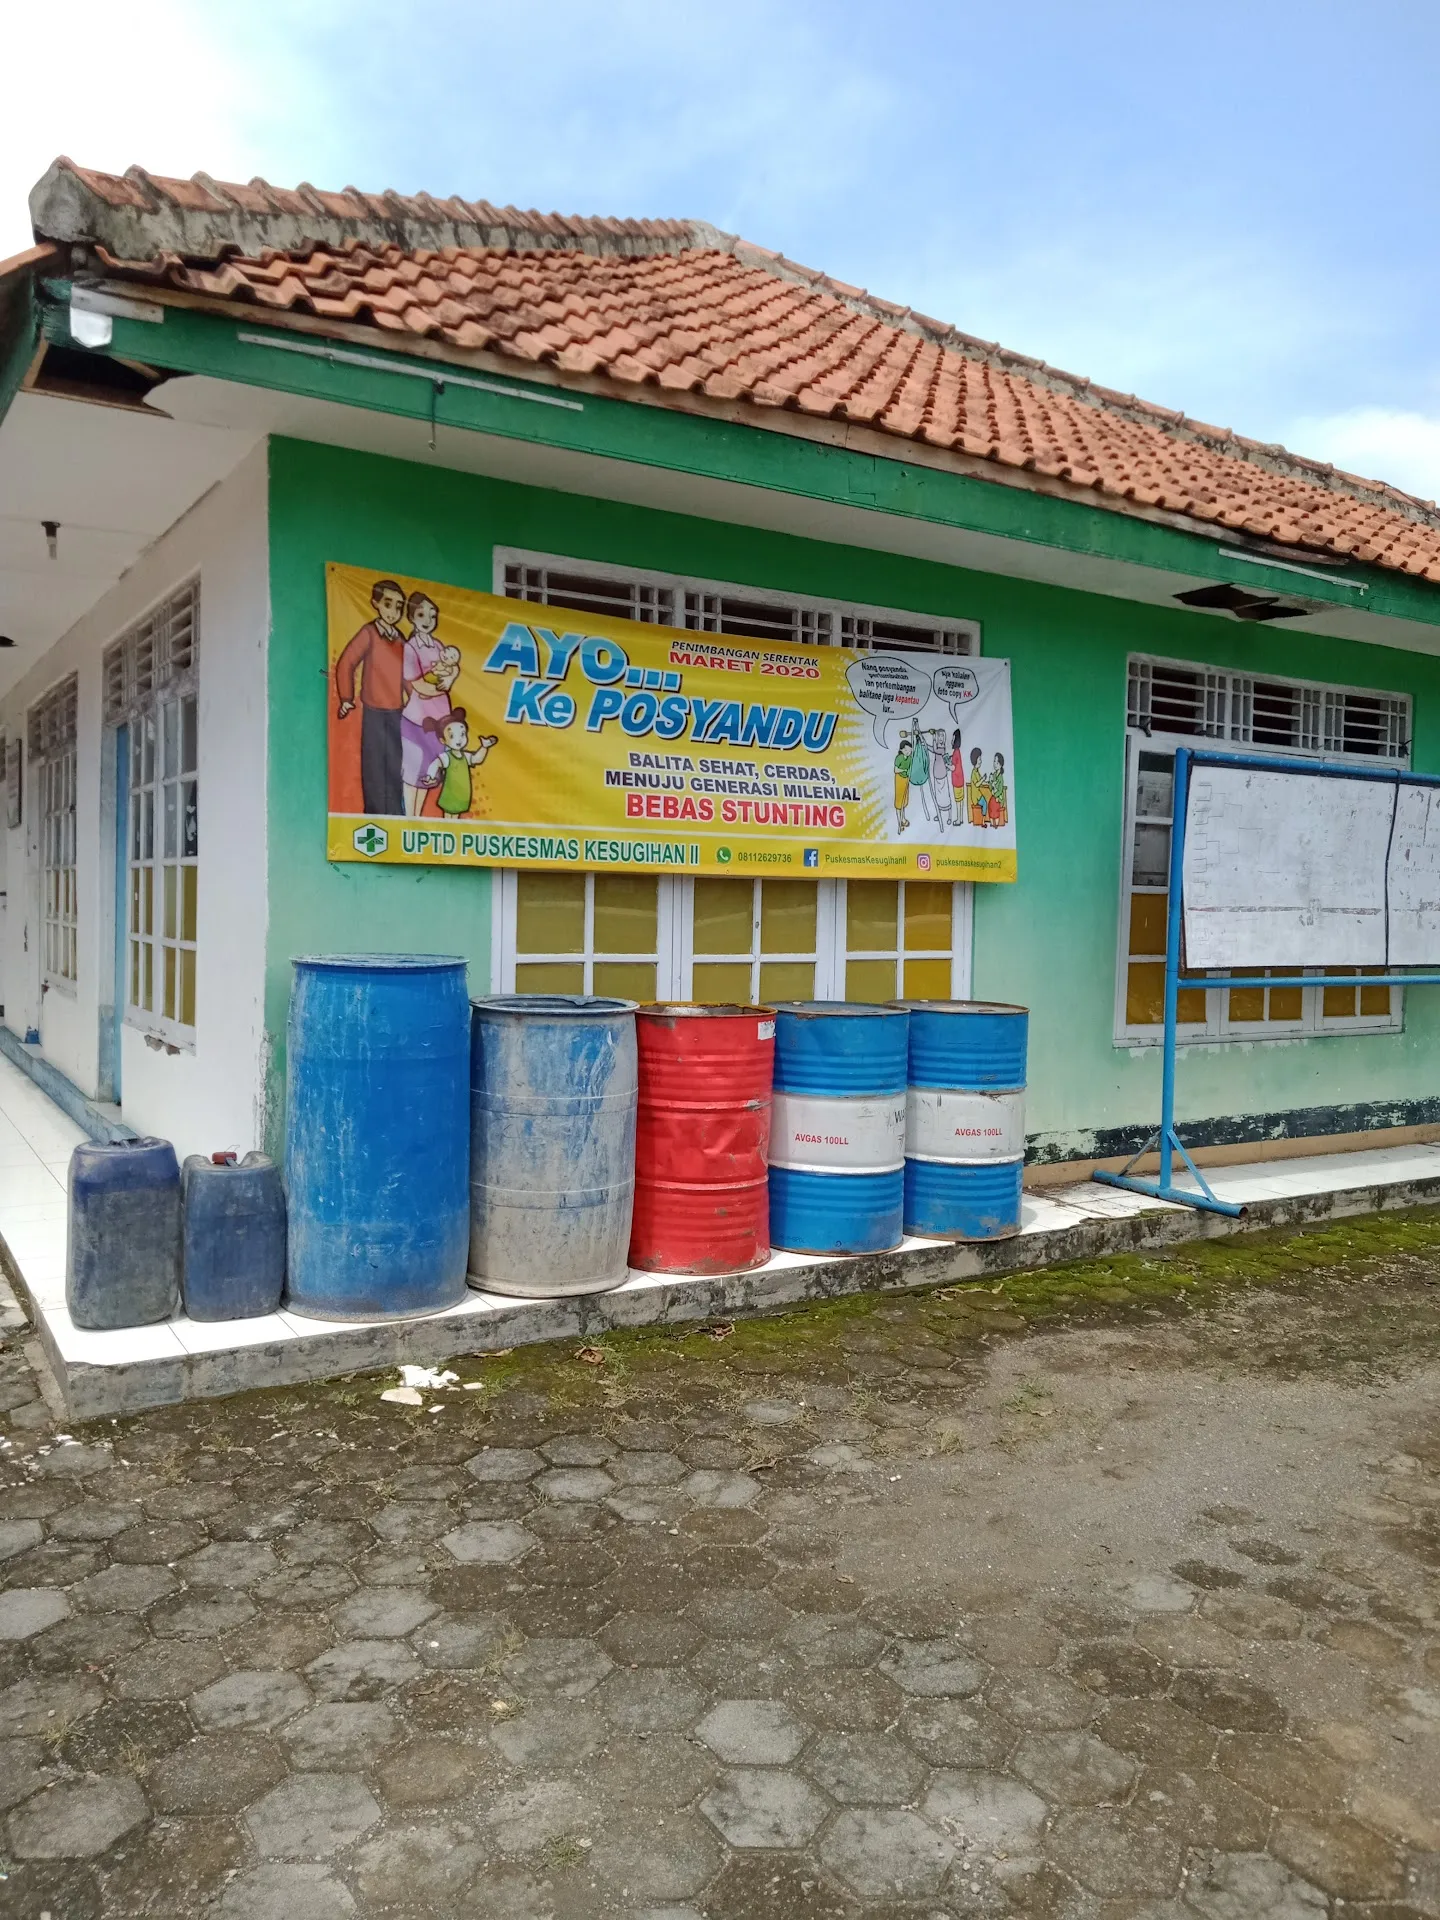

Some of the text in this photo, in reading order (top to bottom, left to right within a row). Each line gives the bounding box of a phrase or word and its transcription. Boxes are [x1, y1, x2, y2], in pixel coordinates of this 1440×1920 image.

[671, 641, 819, 667] PENIMBANGAN SERENTAK
[670, 651, 820, 679] MARET 2020
[861, 662, 878, 673] Nang
[859, 689, 920, 705] balitane juga kepantau
[875, 680, 916, 694] perkembangan
[937, 687, 948, 696] foto
[949, 690, 962, 699] copy
[505, 679, 839, 754] Ke POSYANDU
[629, 752, 836, 785] BALITA SEHAT, CERDAS,
[605, 770, 861, 801] MENUJU GENERASI MILENIAL
[626, 793, 846, 828] BEBAS STUNTING
[402, 831, 699, 864] UPTD PUSKESMAS KESUGIHAN II
[737, 852, 792, 863] 08112629736
[794, 1133, 849, 1146] AVGAS 100LL
[954, 1127, 1003, 1138] AVGAS 100LL
